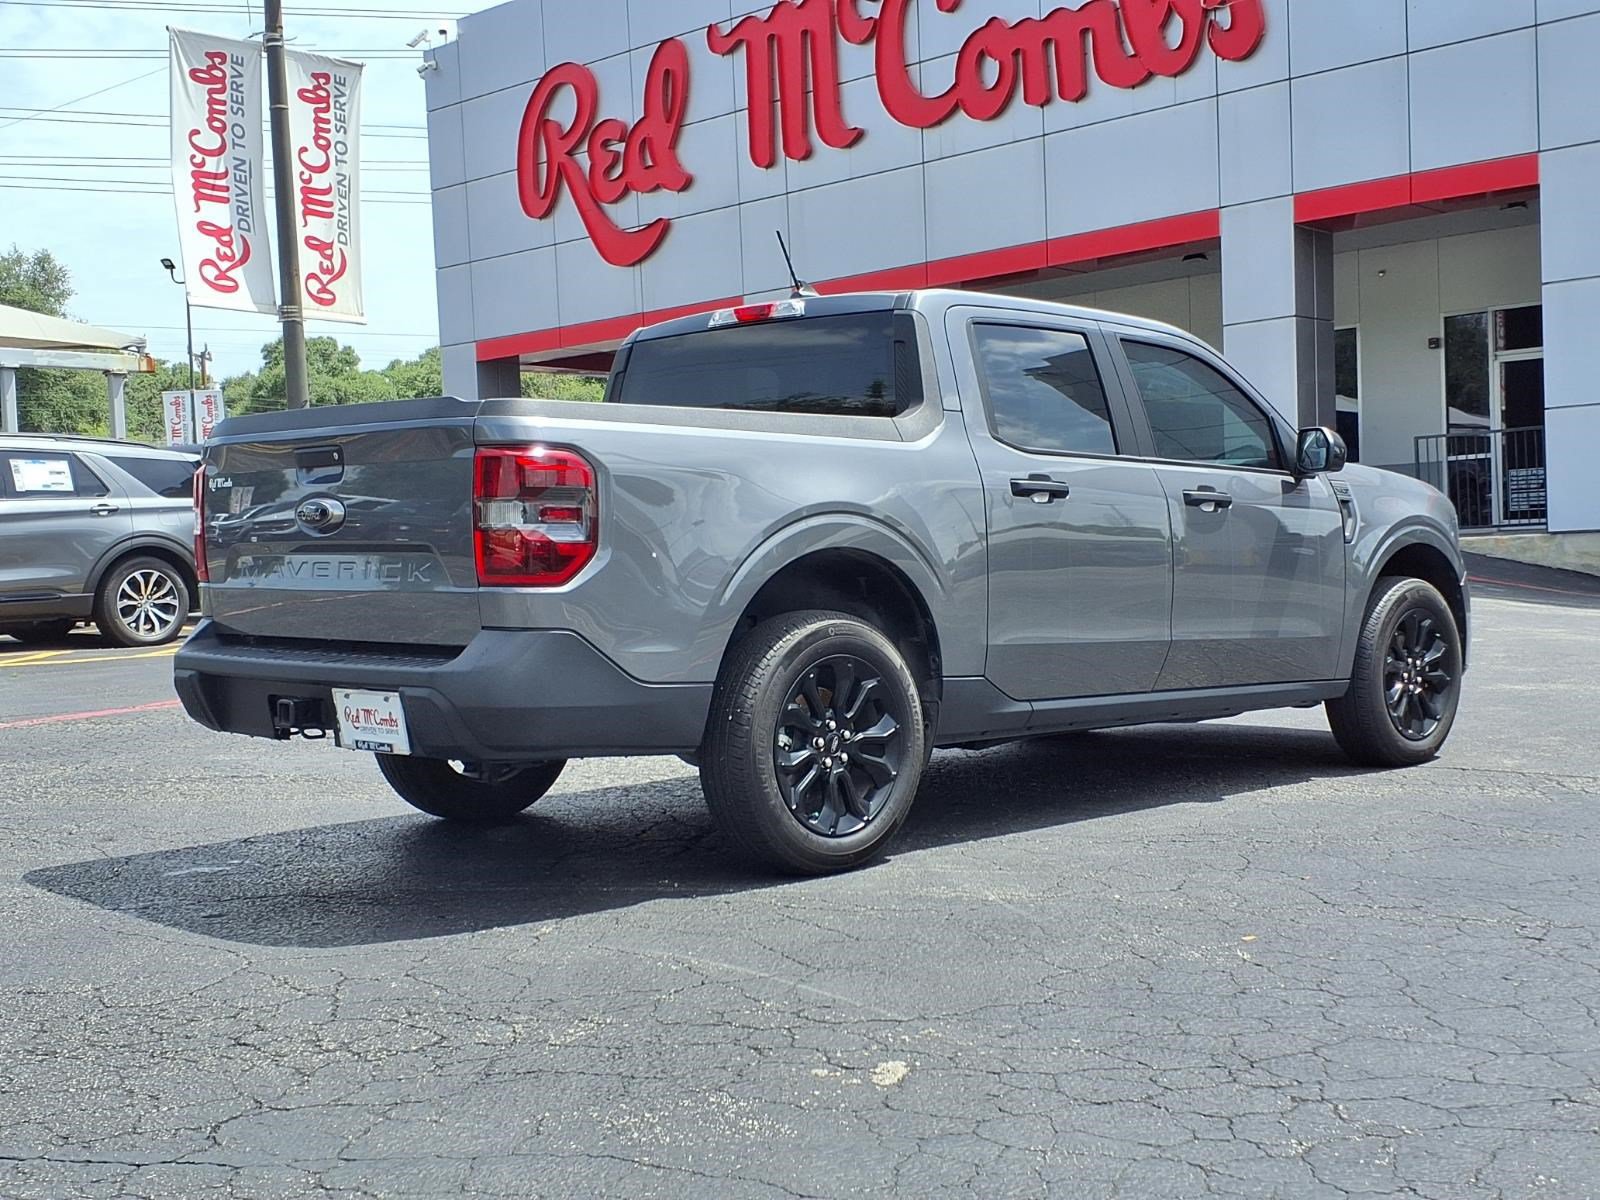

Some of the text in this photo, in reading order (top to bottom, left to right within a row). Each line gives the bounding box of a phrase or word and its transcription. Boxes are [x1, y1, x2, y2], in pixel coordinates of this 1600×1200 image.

[188, 50, 252, 294] Red McCombs
[230, 52, 251, 234] DRIVEN TO SERVE
[297, 71, 347, 307] Red McCombs
[334, 73, 348, 247] DRIVEN TO SERVE
[516, 36, 693, 268] Red
[239, 560, 432, 582] MAVERICK
[344, 706, 399, 729] Red McCombs
